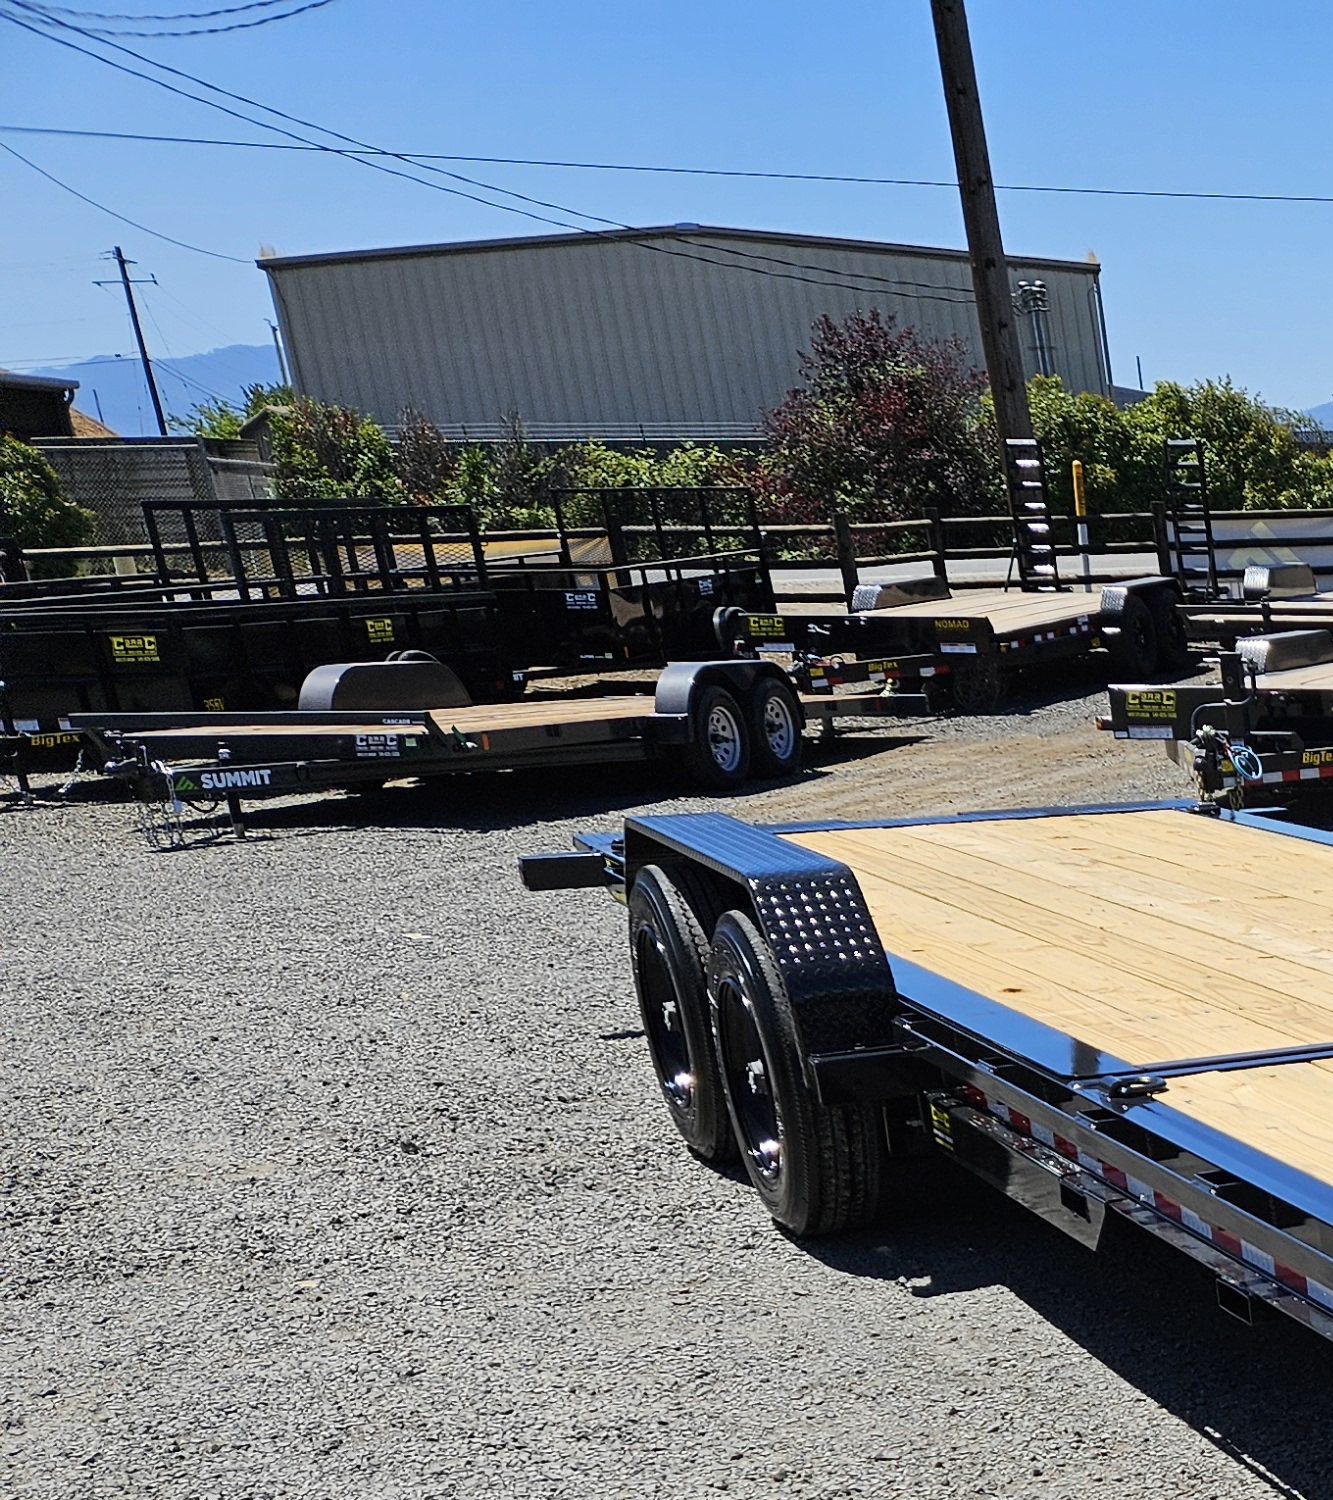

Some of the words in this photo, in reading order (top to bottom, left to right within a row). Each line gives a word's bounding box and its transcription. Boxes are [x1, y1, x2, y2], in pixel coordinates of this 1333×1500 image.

[934, 620, 970, 629] NOMAD
[868, 661, 899, 672] BigTex
[31, 733, 81, 748] BigTex
[200, 769, 272, 789] SUMMIT
